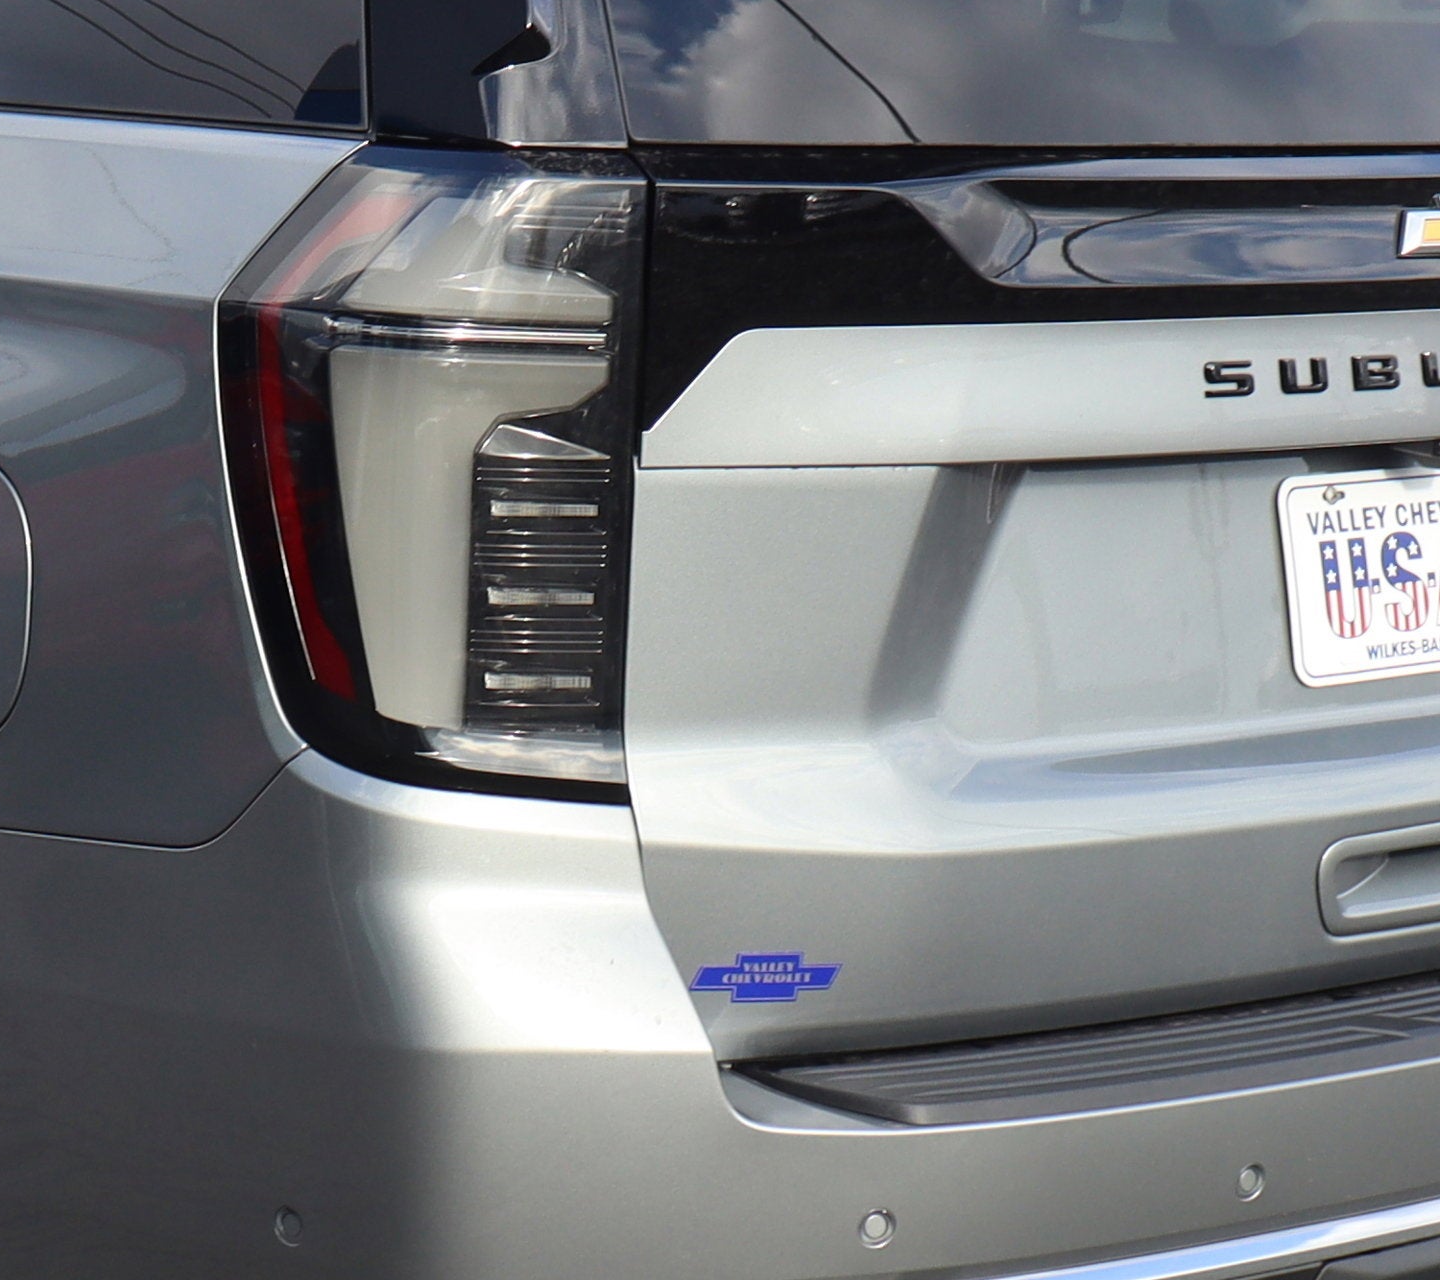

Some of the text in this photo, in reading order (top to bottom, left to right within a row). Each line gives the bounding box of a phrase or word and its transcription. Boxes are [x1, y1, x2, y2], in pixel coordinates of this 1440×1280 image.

[1306, 506, 1386, 536] VALLEY
[742, 962, 796, 973] VALLEY
[722, 973, 813, 985] CHEVROLET
